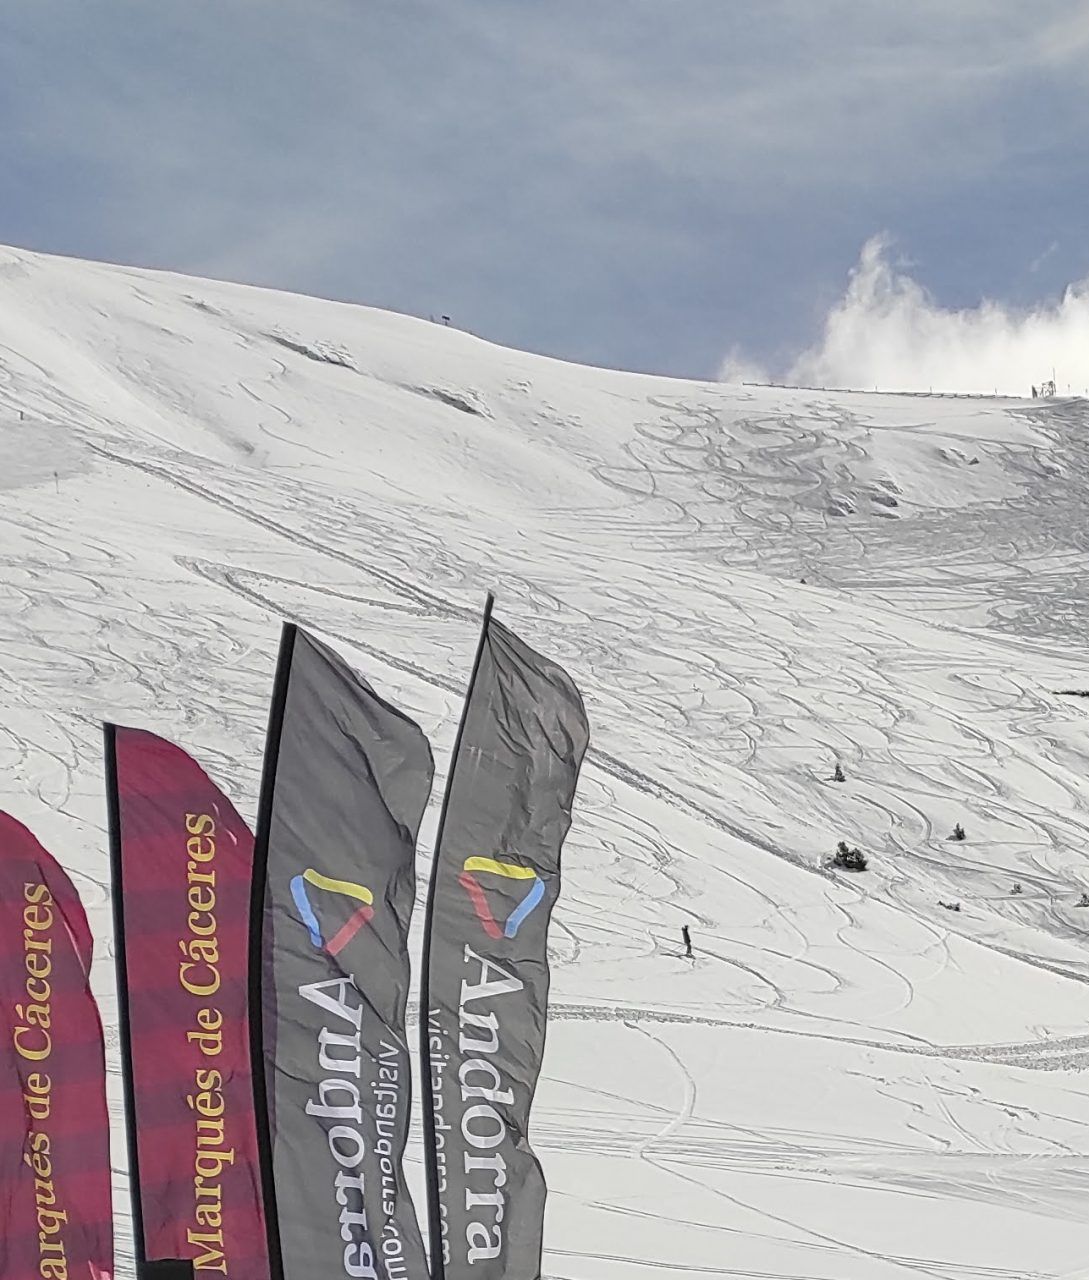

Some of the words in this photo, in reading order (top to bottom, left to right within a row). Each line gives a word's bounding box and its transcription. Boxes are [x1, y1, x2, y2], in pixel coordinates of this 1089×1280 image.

[14, 882, 53, 1061] Cáceres
[178, 813, 221, 996] Cáceres
[24, 1073, 51, 1119] de
[186, 1008, 223, 1056] de
[458, 943, 524, 1265] Andorra
[186, 1069, 235, 1276] Marqués
